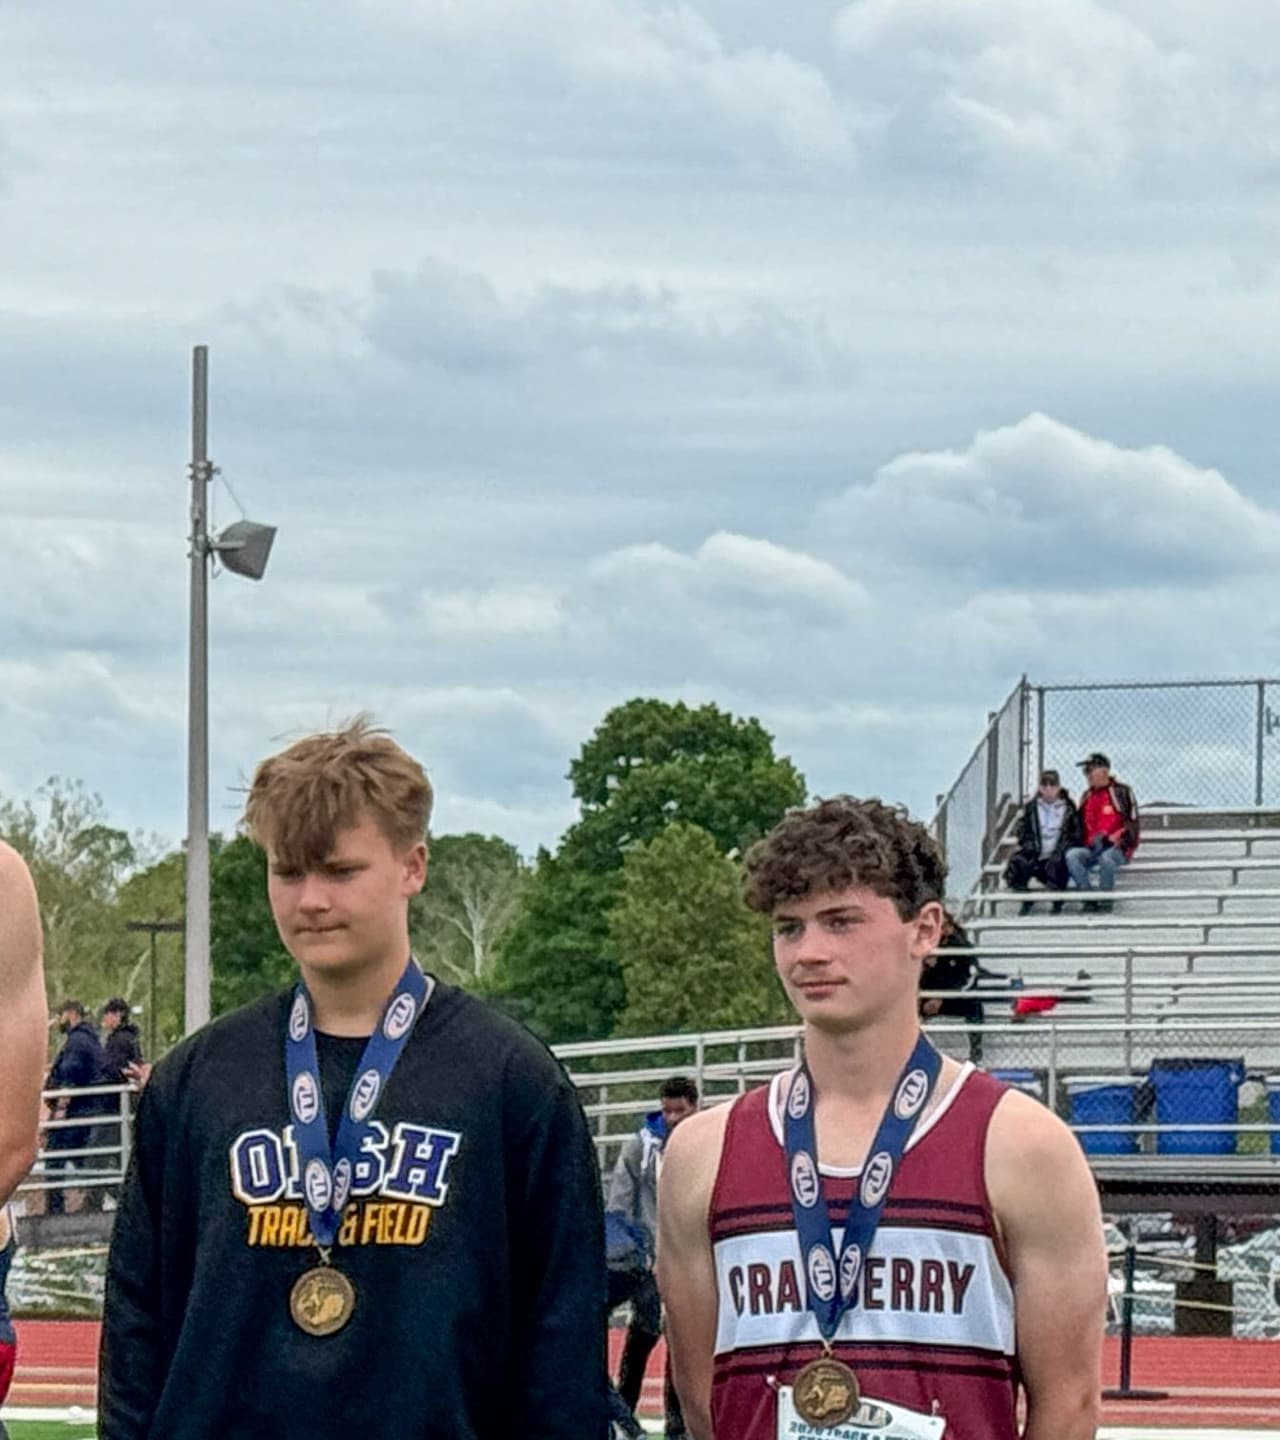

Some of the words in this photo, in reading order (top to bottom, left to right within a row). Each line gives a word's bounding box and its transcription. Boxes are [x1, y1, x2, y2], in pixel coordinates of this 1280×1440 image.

[248, 1205, 318, 1247] TRAC
[339, 1204, 358, 1247] &
[361, 1204, 431, 1246] FIELD
[729, 1257, 977, 1317] CRAERRY
